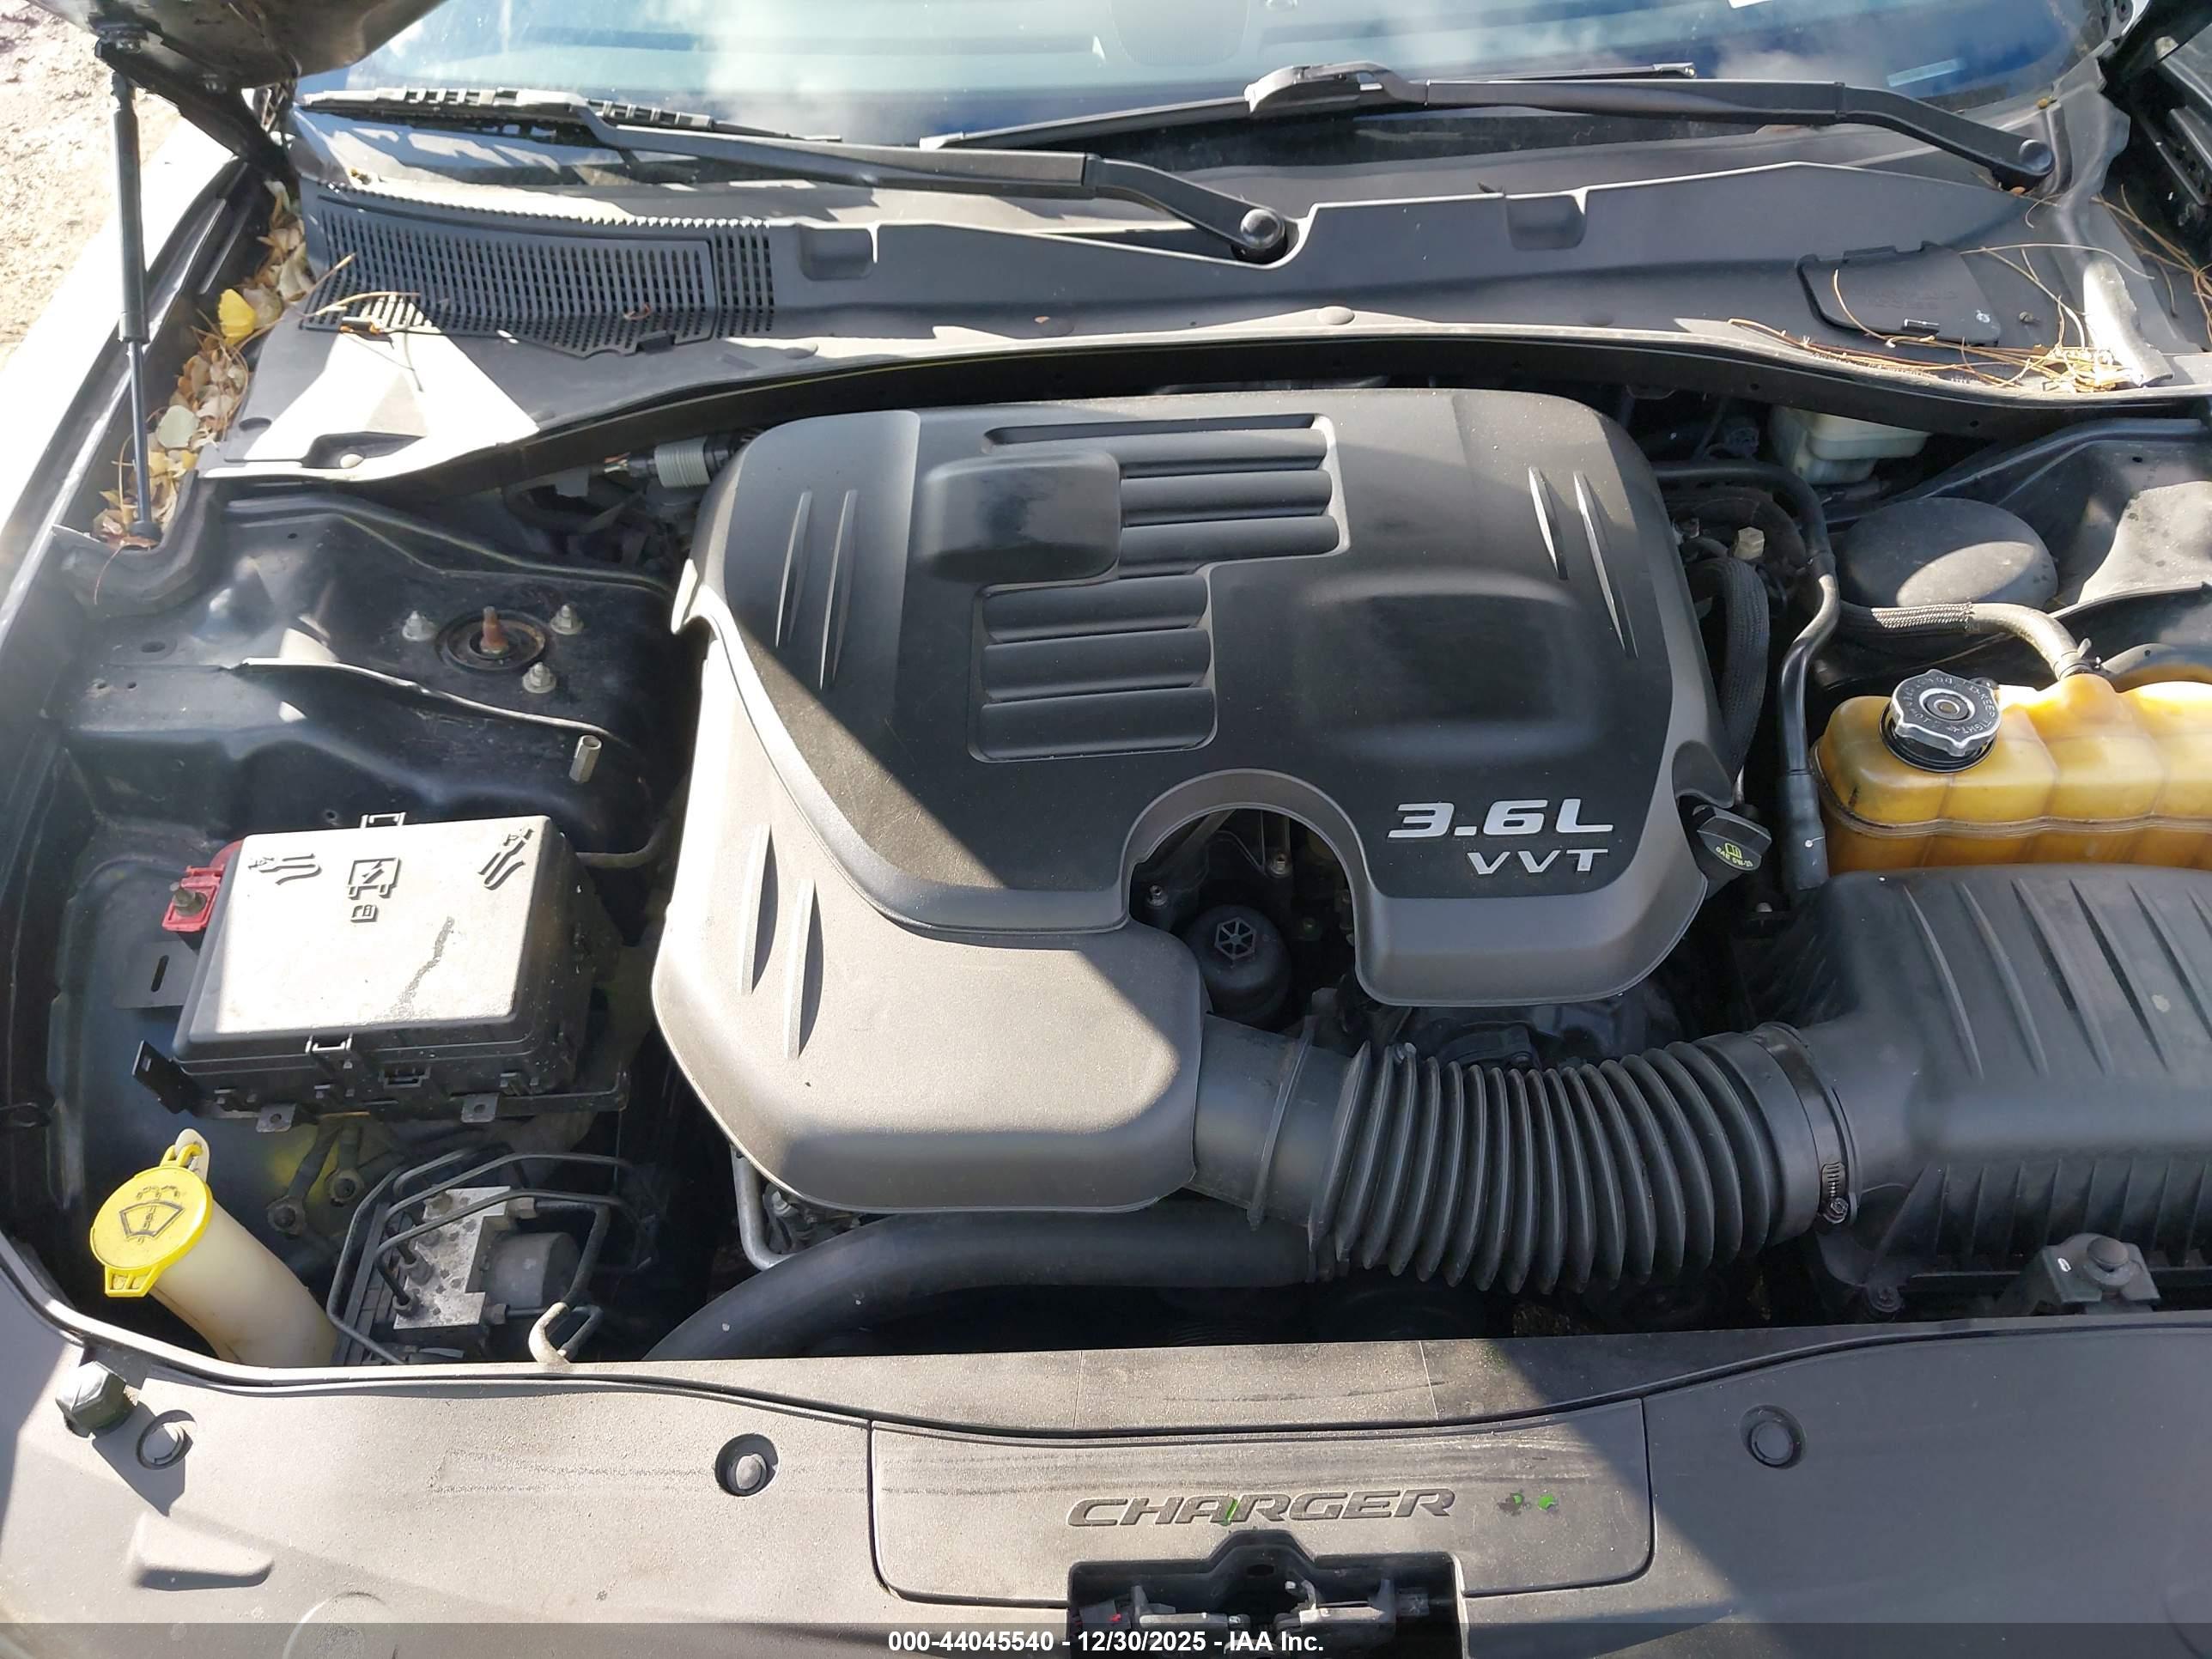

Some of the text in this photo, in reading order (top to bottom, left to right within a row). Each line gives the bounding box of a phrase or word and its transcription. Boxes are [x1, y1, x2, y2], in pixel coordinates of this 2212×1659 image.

[1388, 799, 1613, 838] 3.6L
[1467, 848, 1608, 875] VVT
[1067, 1488, 1455, 1527] CHARGER
